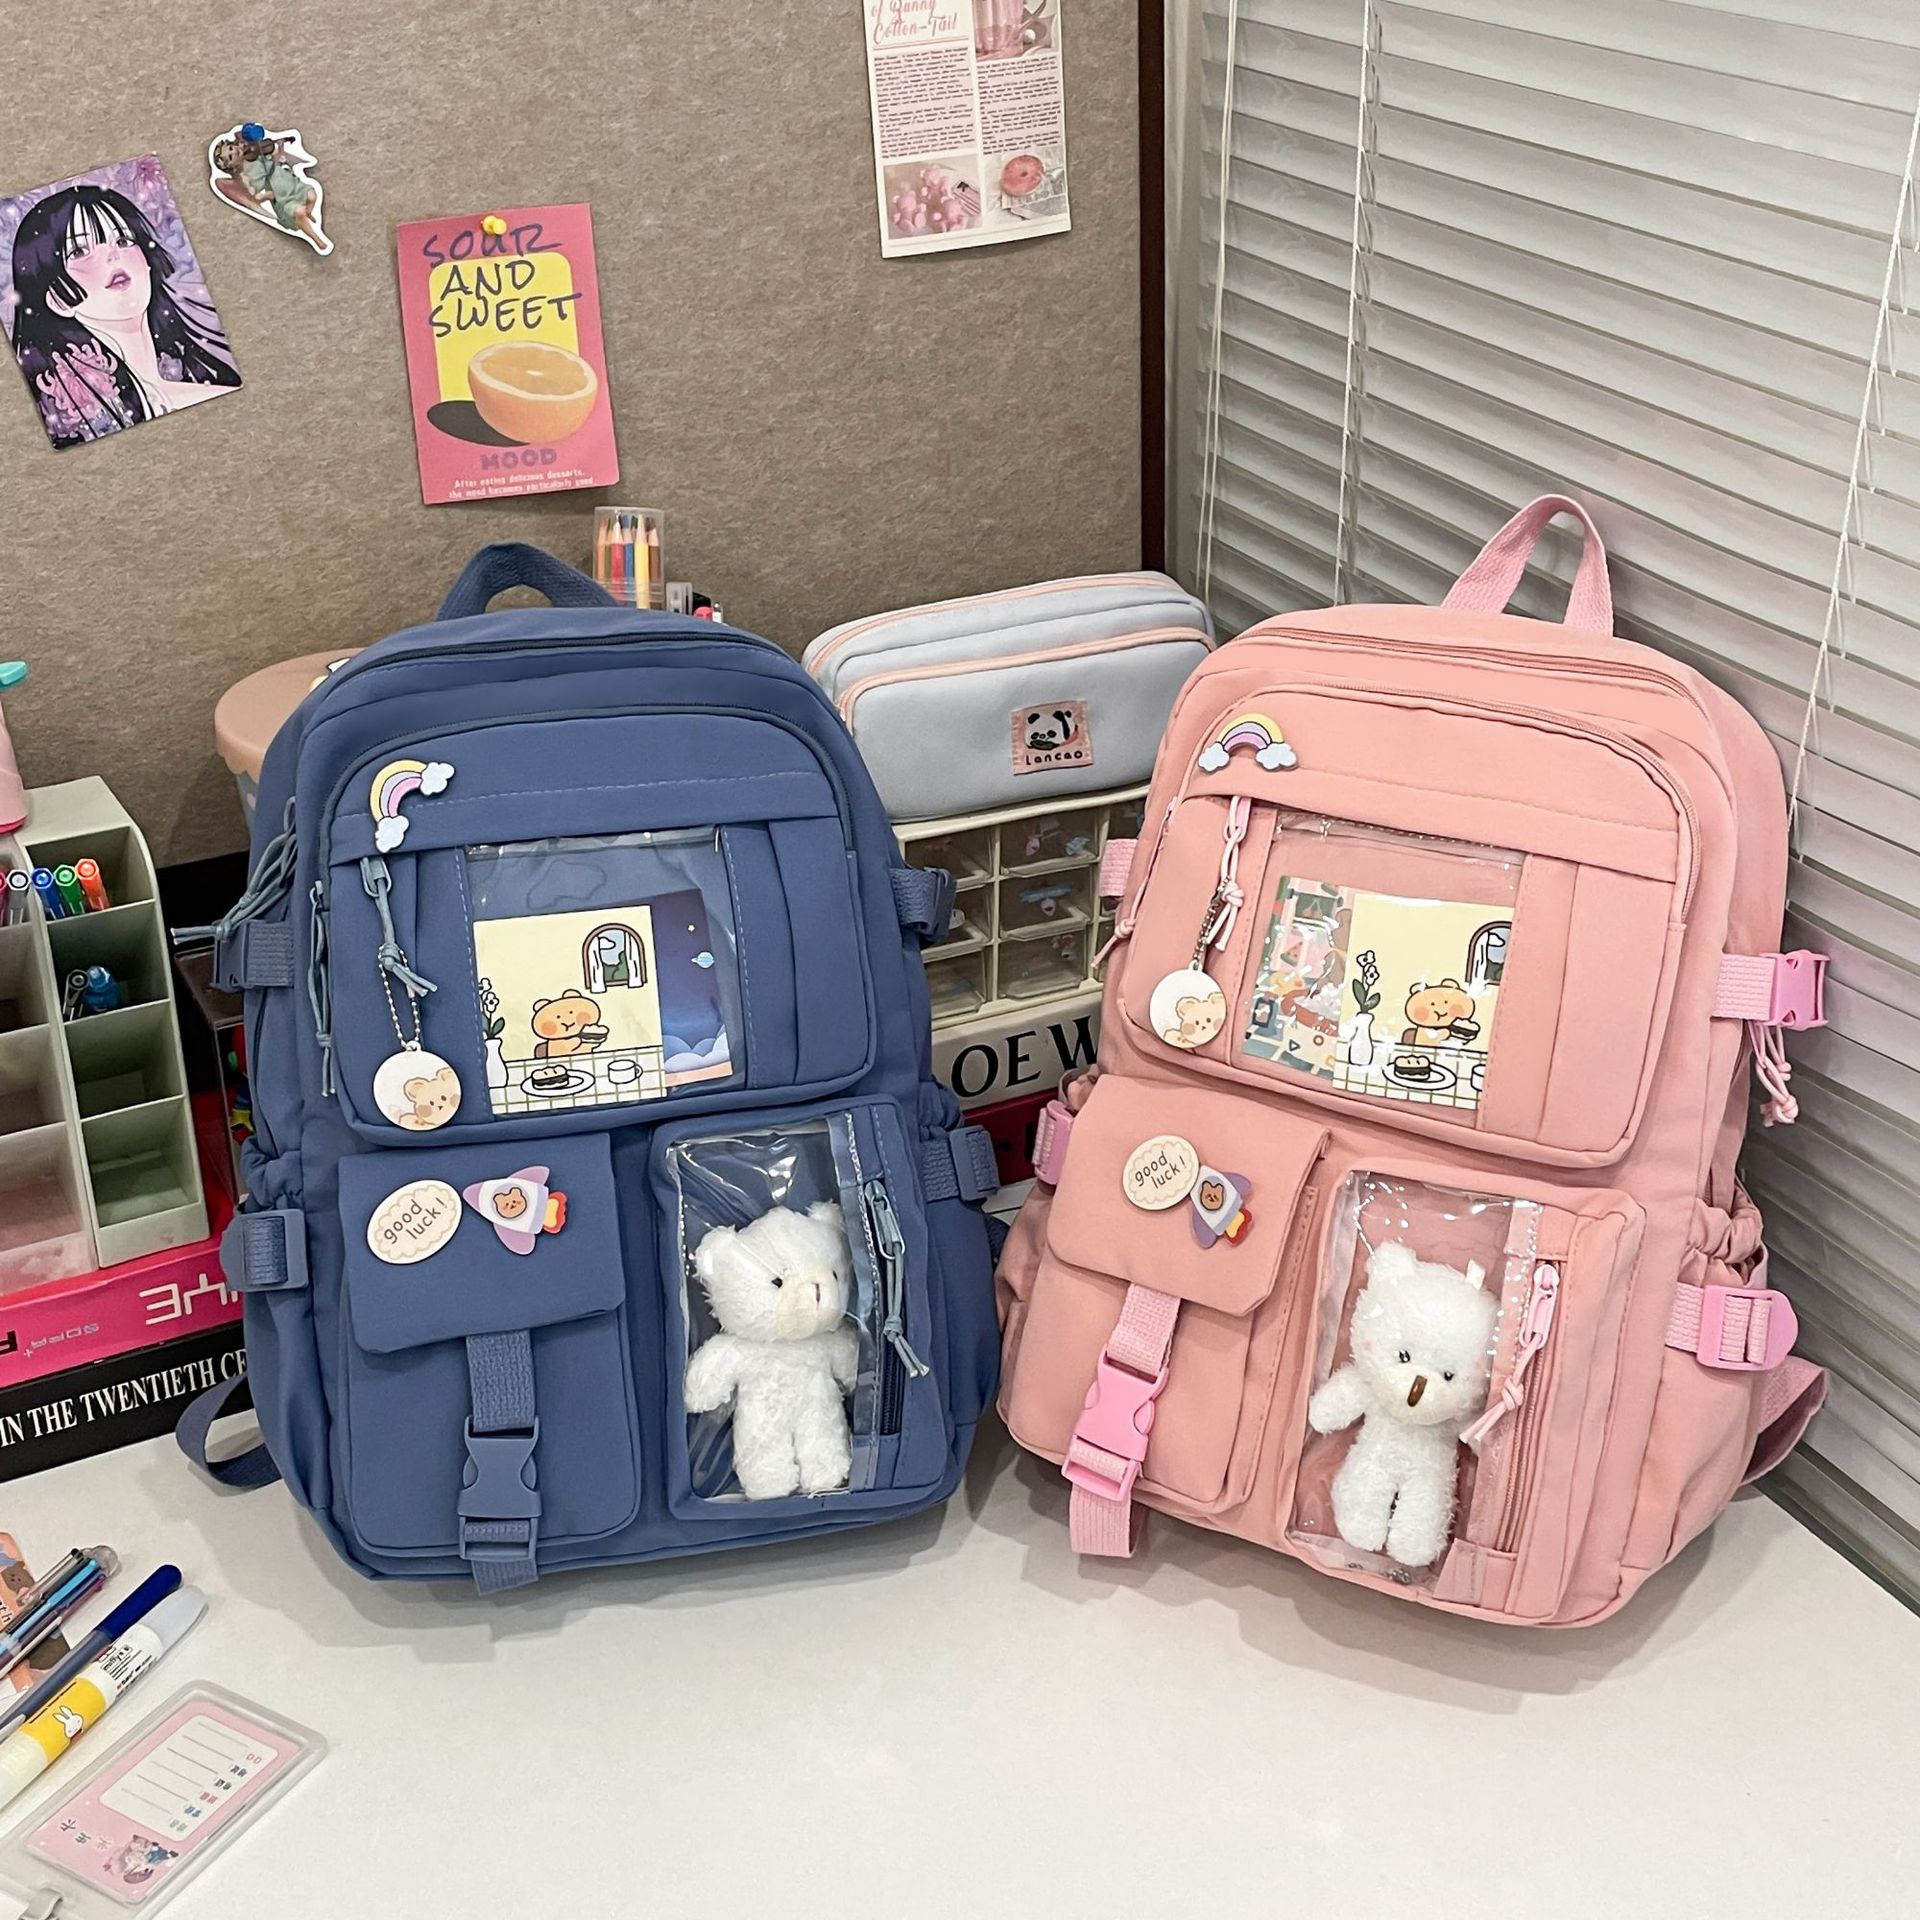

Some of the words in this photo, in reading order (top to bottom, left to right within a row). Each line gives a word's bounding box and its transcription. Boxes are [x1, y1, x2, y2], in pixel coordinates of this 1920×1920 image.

[423, 223, 562, 268] SOUR
[440, 259, 535, 301] AND
[428, 292, 583, 338] SWEET
[481, 448, 557, 470] MOOD
[1135, 1151, 1168, 1187] good
[383, 1199, 423, 1244] good
[0, 1413, 25, 1448] IN
[27, 1398, 78, 1438] THE
[79, 1357, 216, 1423] TWENTIETH
